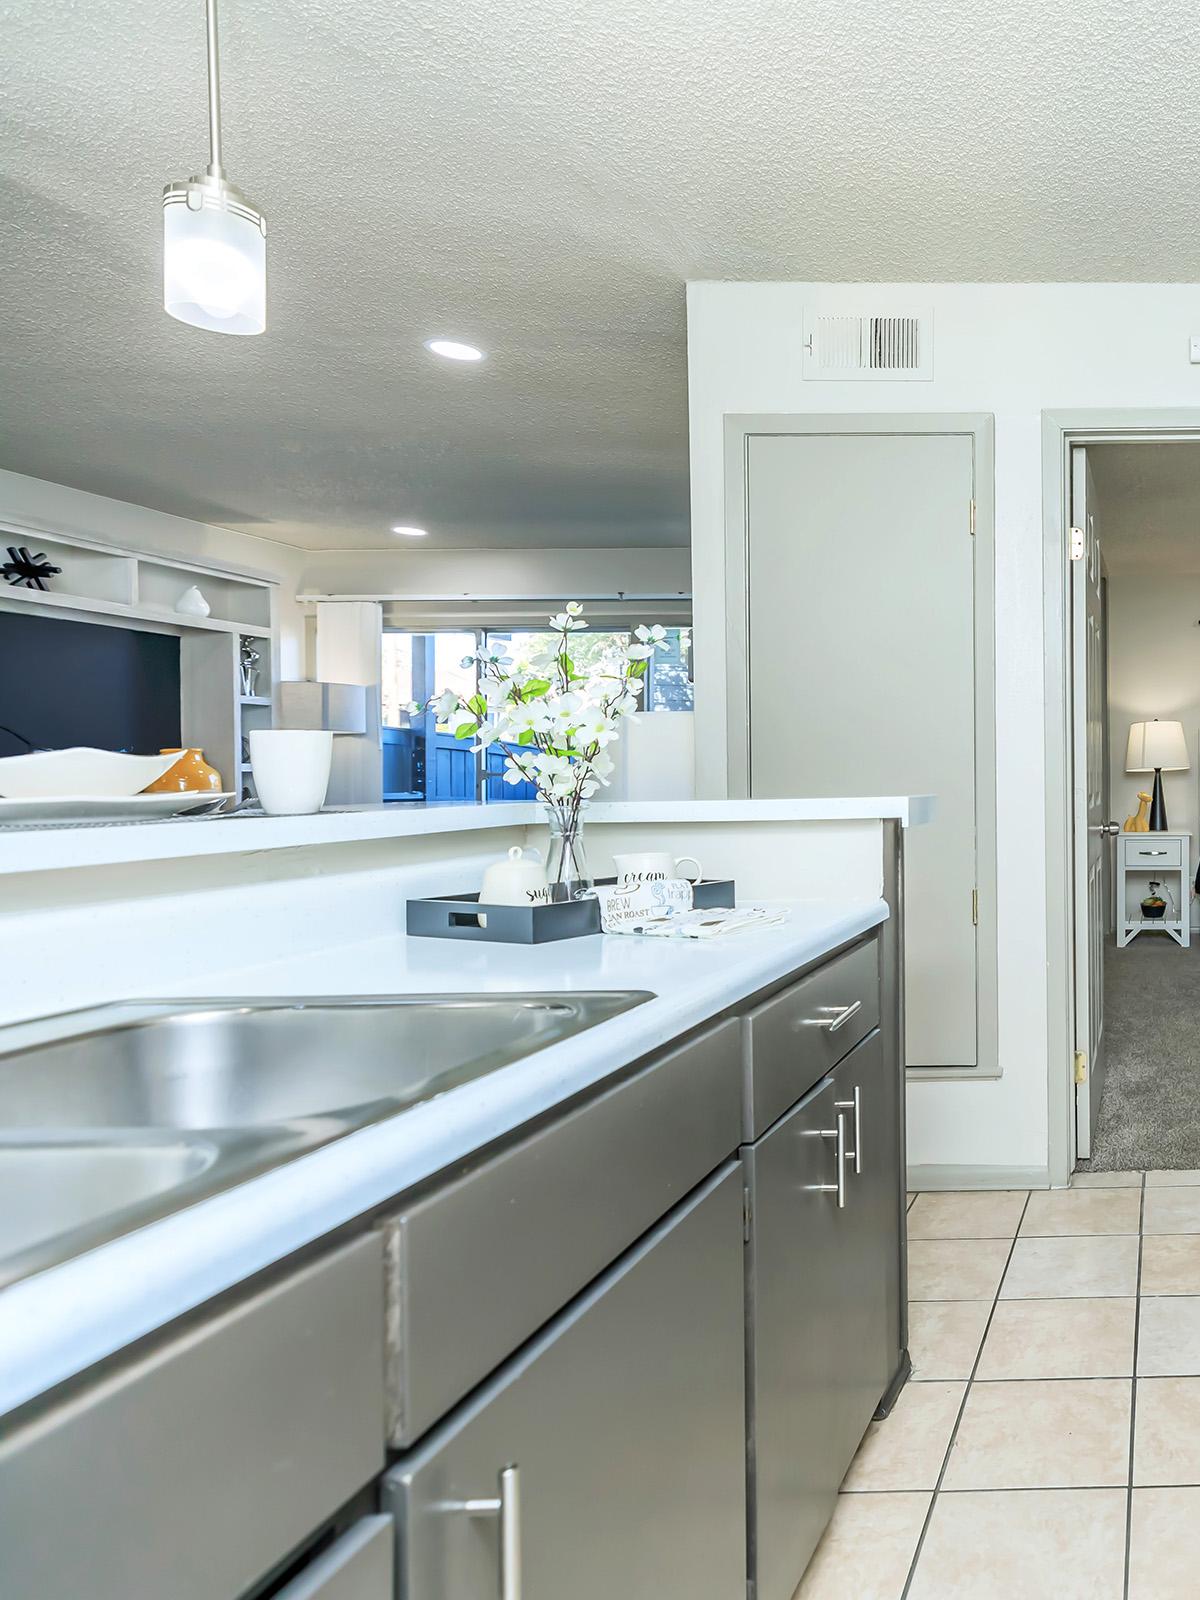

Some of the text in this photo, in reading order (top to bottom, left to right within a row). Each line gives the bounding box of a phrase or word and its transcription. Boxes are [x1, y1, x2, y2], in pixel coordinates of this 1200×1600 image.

[624, 872, 667, 883] cream
[606, 897, 631, 912] BREW
[624, 909, 650, 919] ROAST
